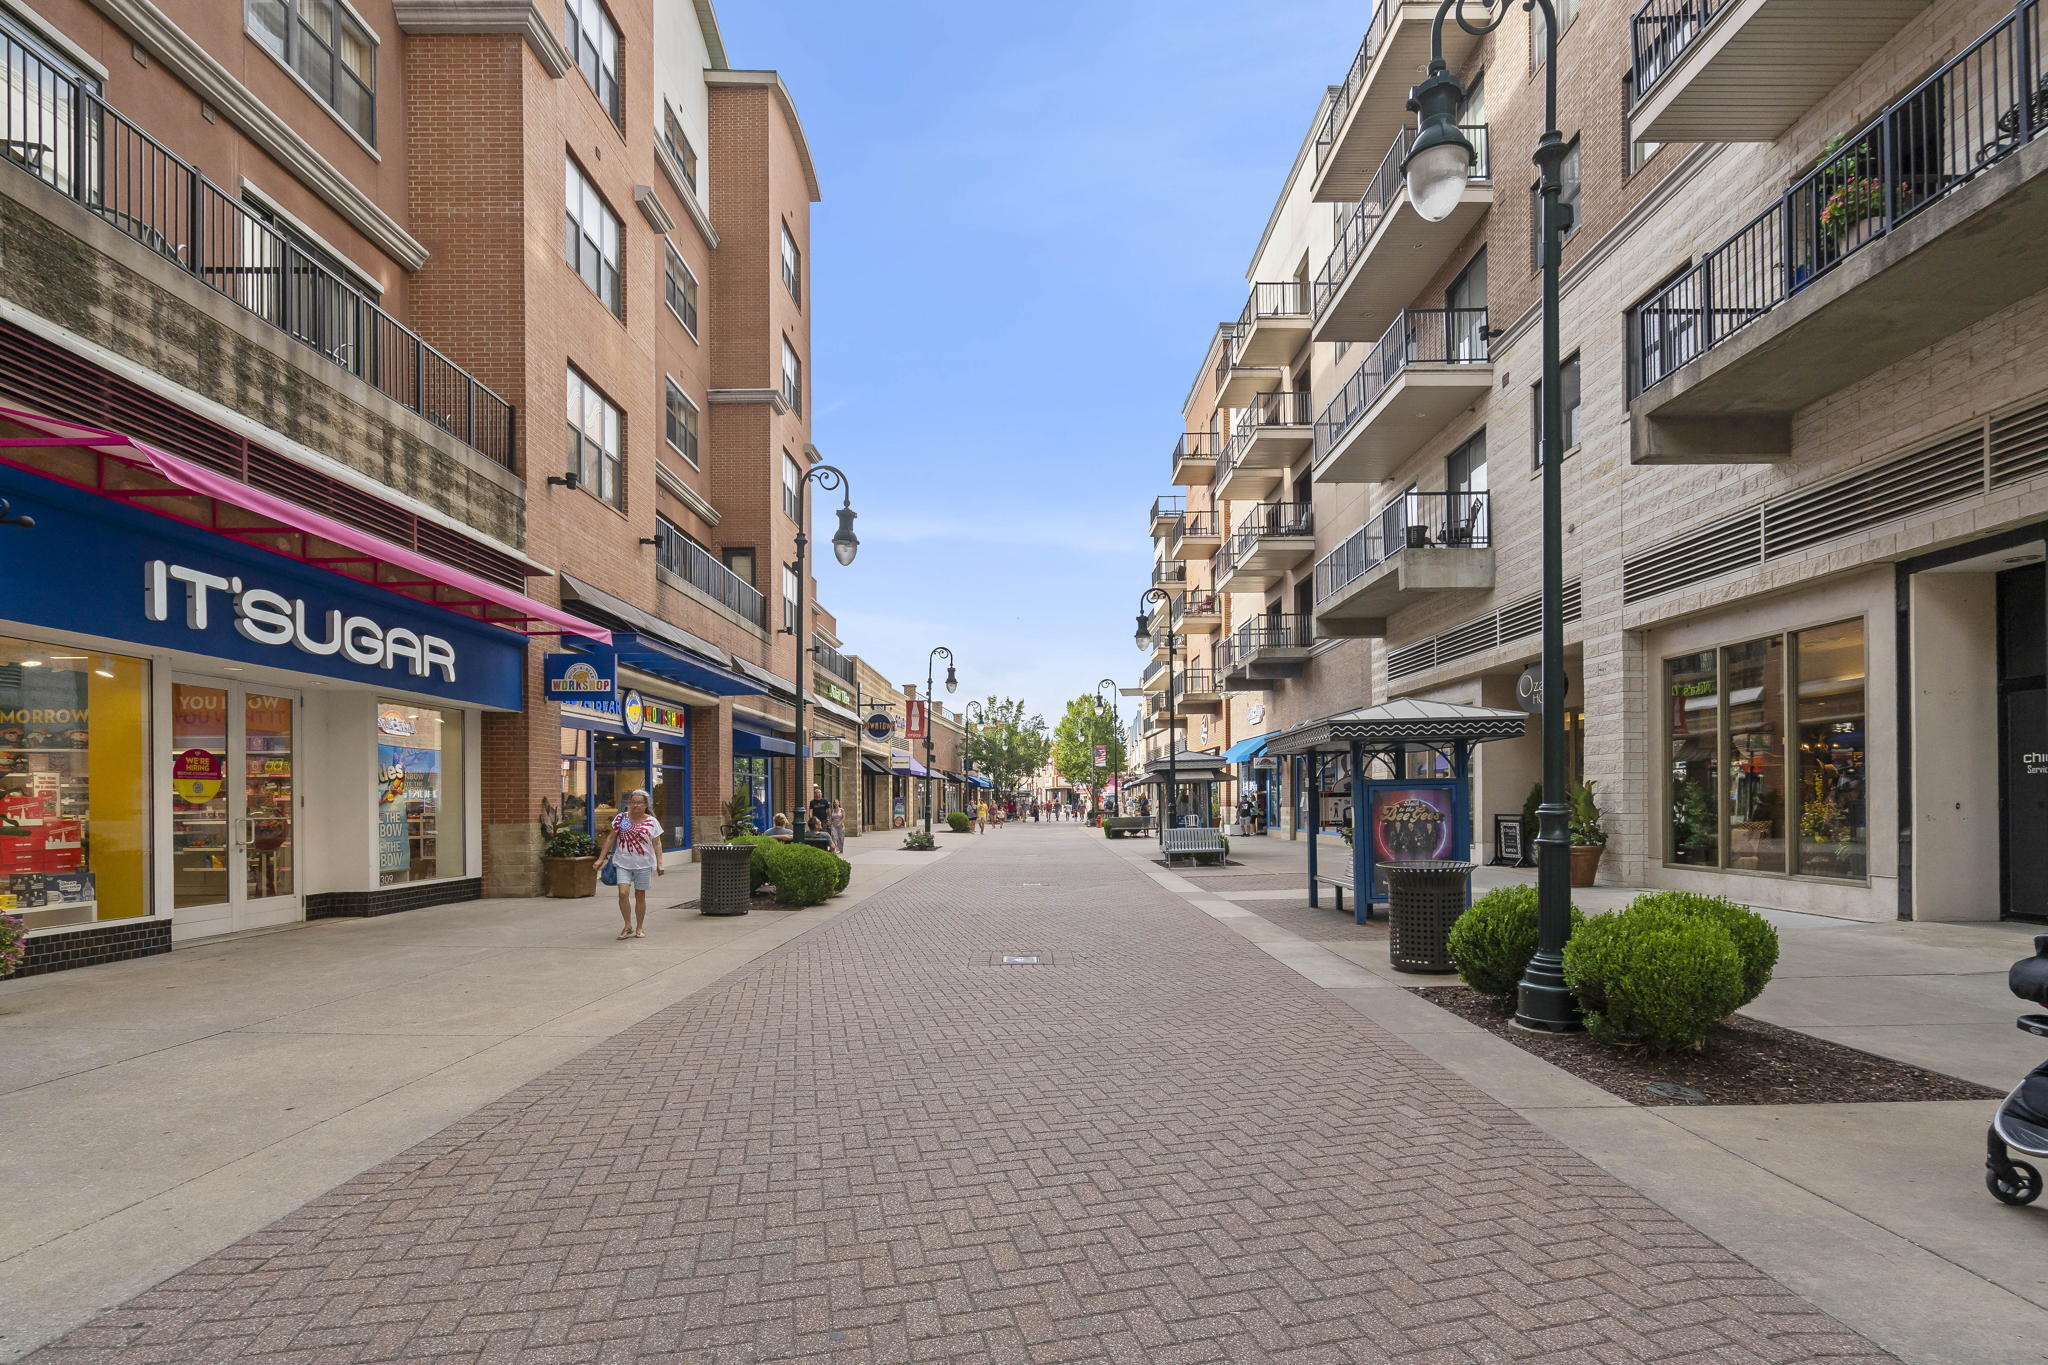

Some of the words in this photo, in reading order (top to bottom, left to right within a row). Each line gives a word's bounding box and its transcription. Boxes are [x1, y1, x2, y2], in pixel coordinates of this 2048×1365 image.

[145, 560, 455, 682] IT'SUGAR
[552, 680, 609, 691] WORKSHOP
[180, 696, 217, 710] YOU
[185, 764, 210, 772] HIRING
[385, 811, 401, 823] THE
[386, 840, 401, 852] THE
[380, 874, 394, 886] 309
